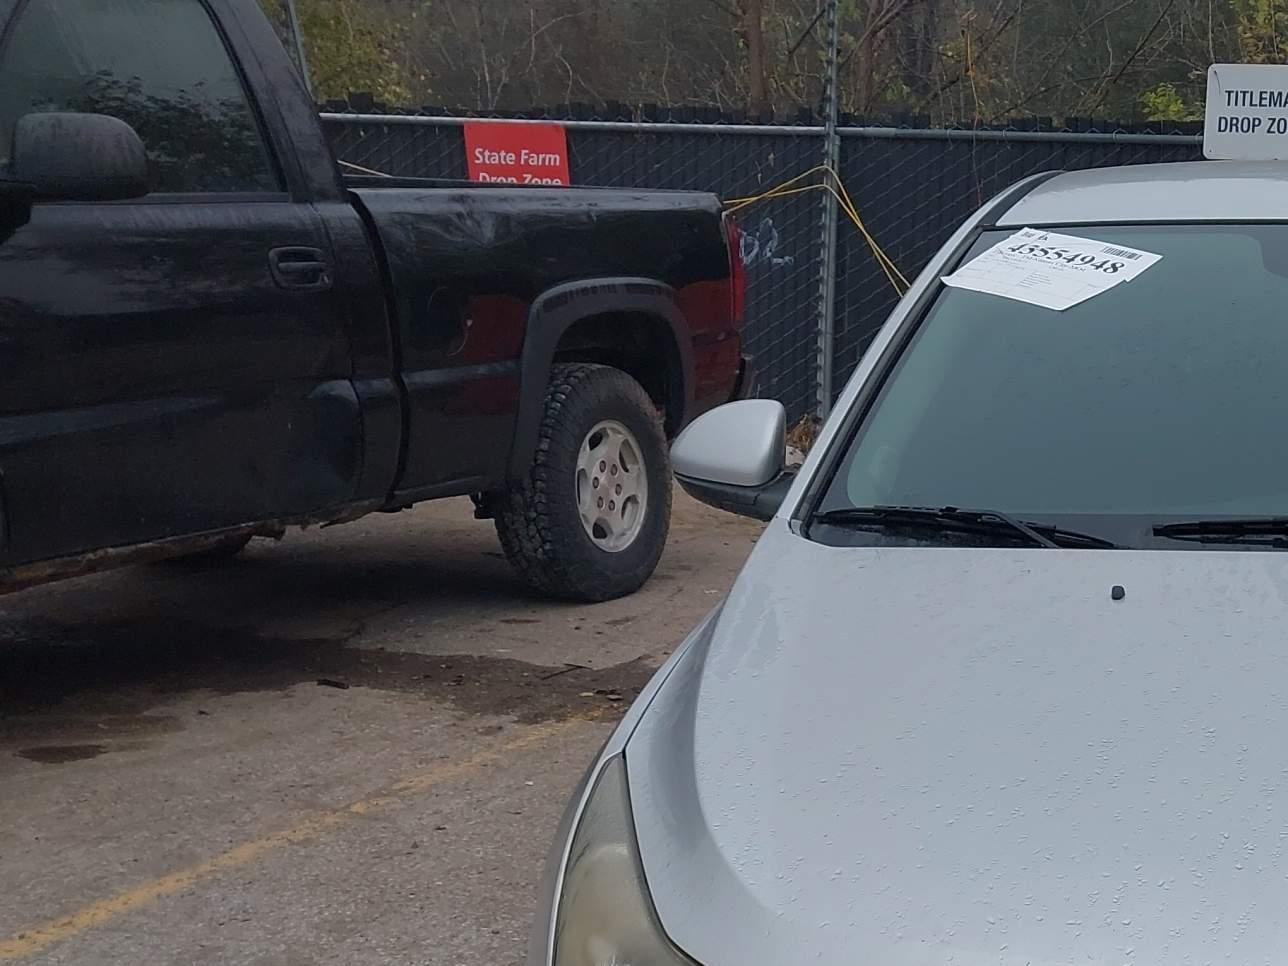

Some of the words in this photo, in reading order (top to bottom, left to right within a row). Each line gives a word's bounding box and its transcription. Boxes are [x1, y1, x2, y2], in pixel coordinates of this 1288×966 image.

[1217, 116, 1262, 134] DROP
[474, 148, 516, 165] State
[520, 149, 560, 166] Farm
[1007, 243, 1125, 274] 43554948
